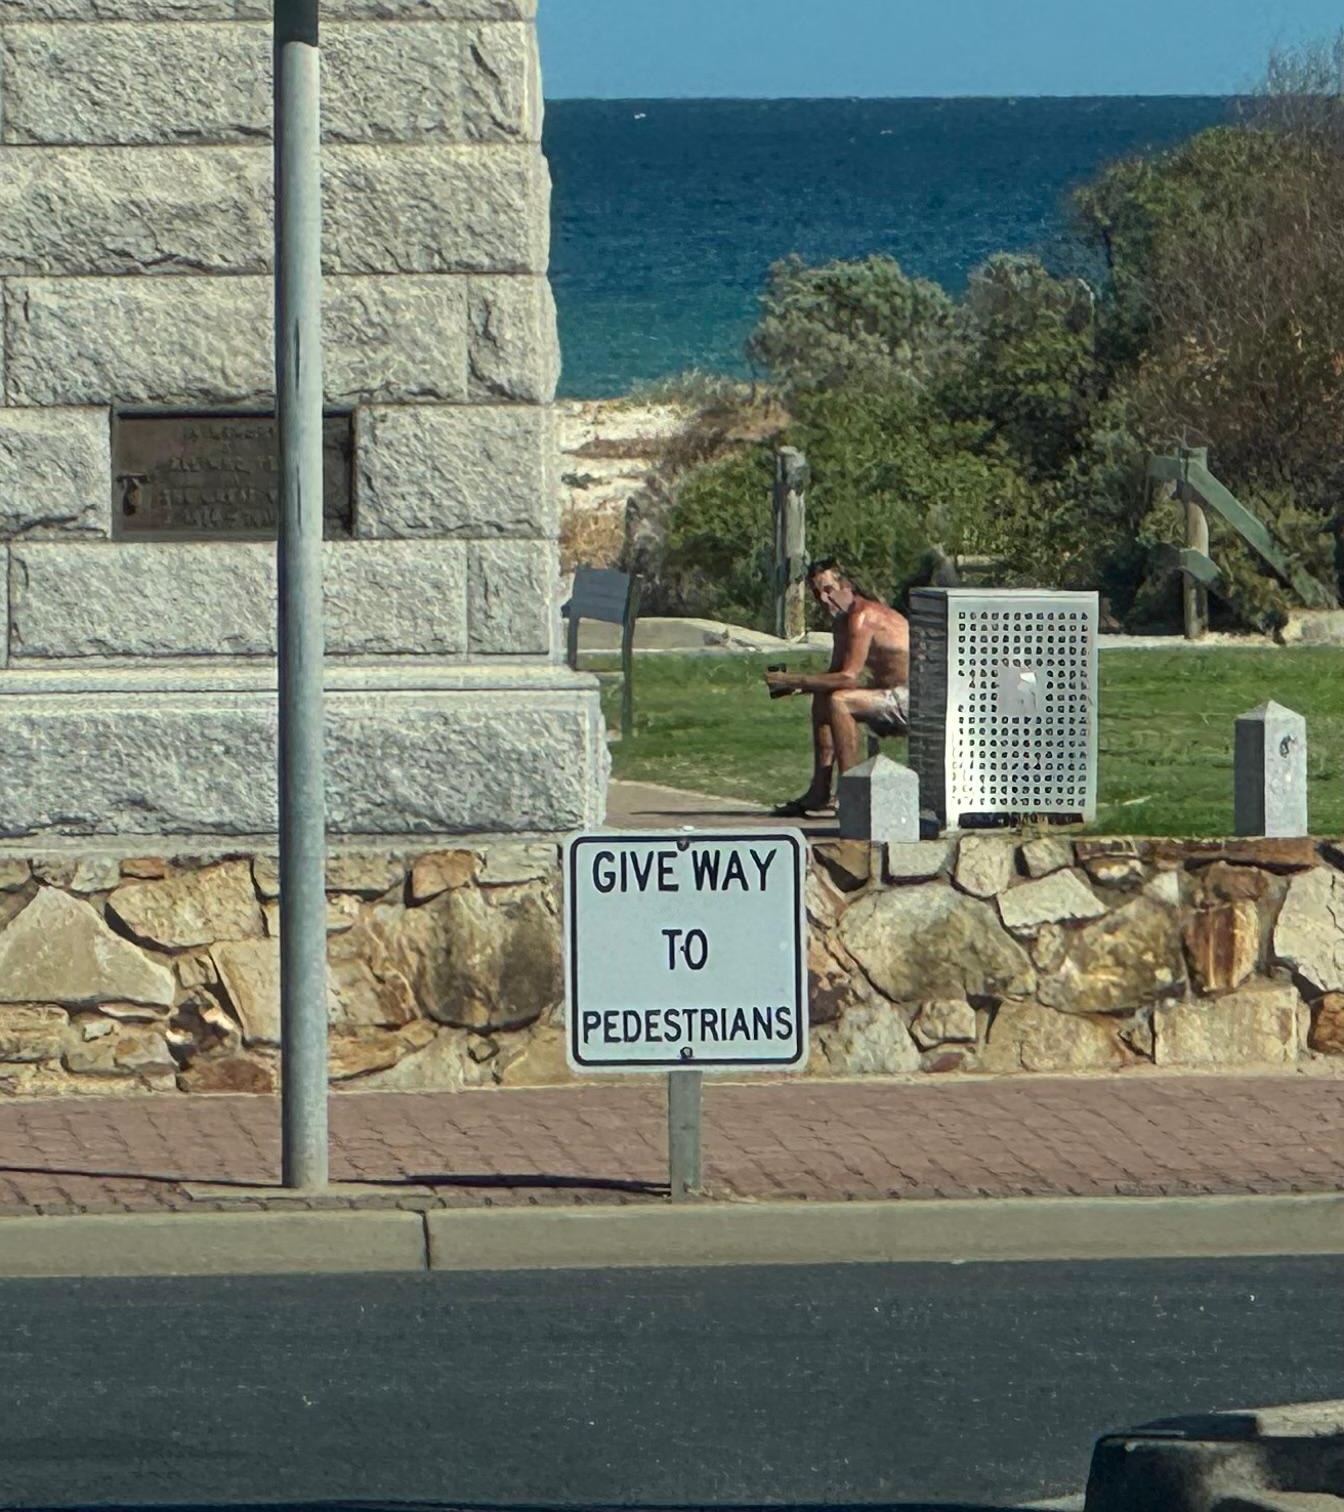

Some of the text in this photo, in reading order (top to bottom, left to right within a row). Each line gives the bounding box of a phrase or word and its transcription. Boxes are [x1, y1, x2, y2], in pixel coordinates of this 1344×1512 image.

[592, 848, 777, 893] GIVE WAY
[661, 928, 709, 971] TO
[583, 1006, 794, 1045] PEDESTRIANS
